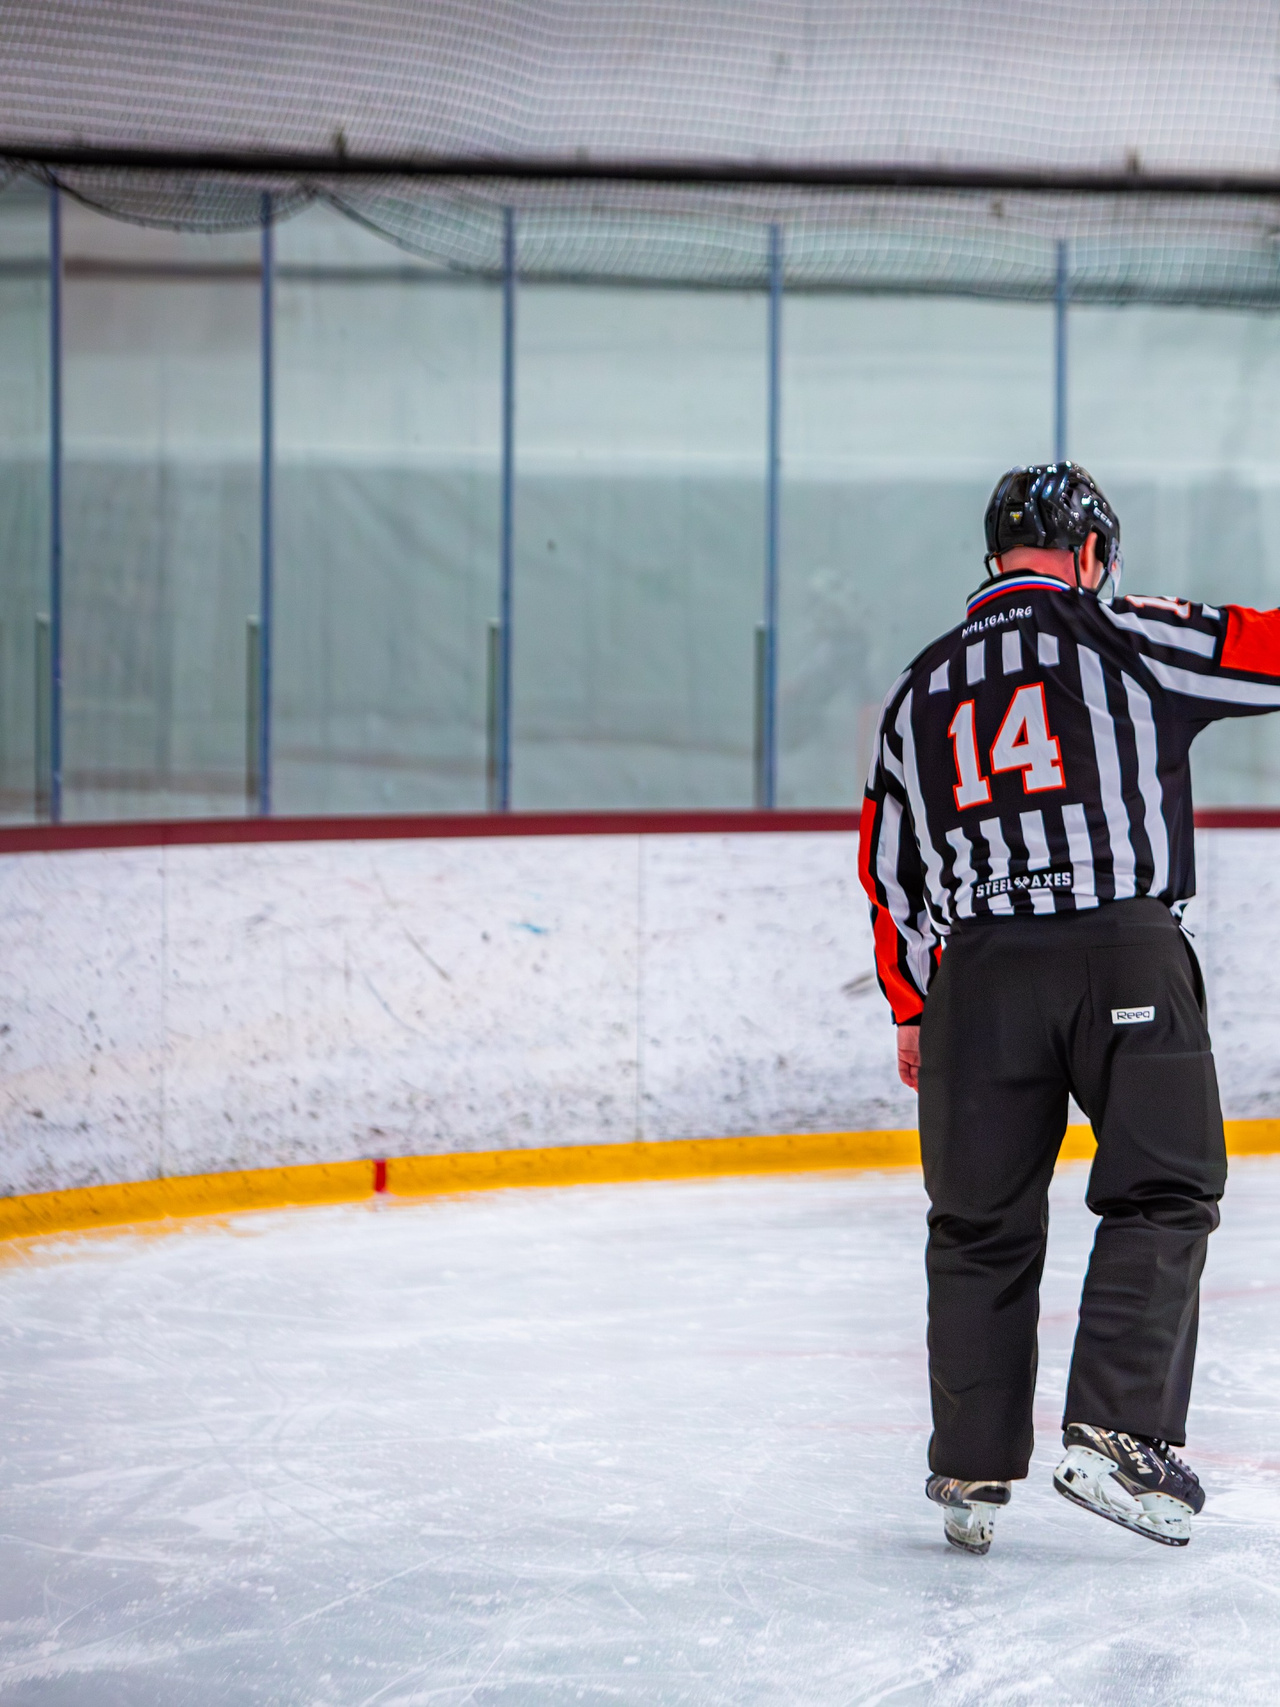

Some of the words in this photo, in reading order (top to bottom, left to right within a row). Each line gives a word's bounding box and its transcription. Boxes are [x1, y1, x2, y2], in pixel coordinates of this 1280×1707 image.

[962, 605, 1033, 639] NHLIGA.ORG
[947, 681, 1067, 812] 14
[976, 878, 1013, 898] STEEL
[1031, 872, 1072, 888] AXES
